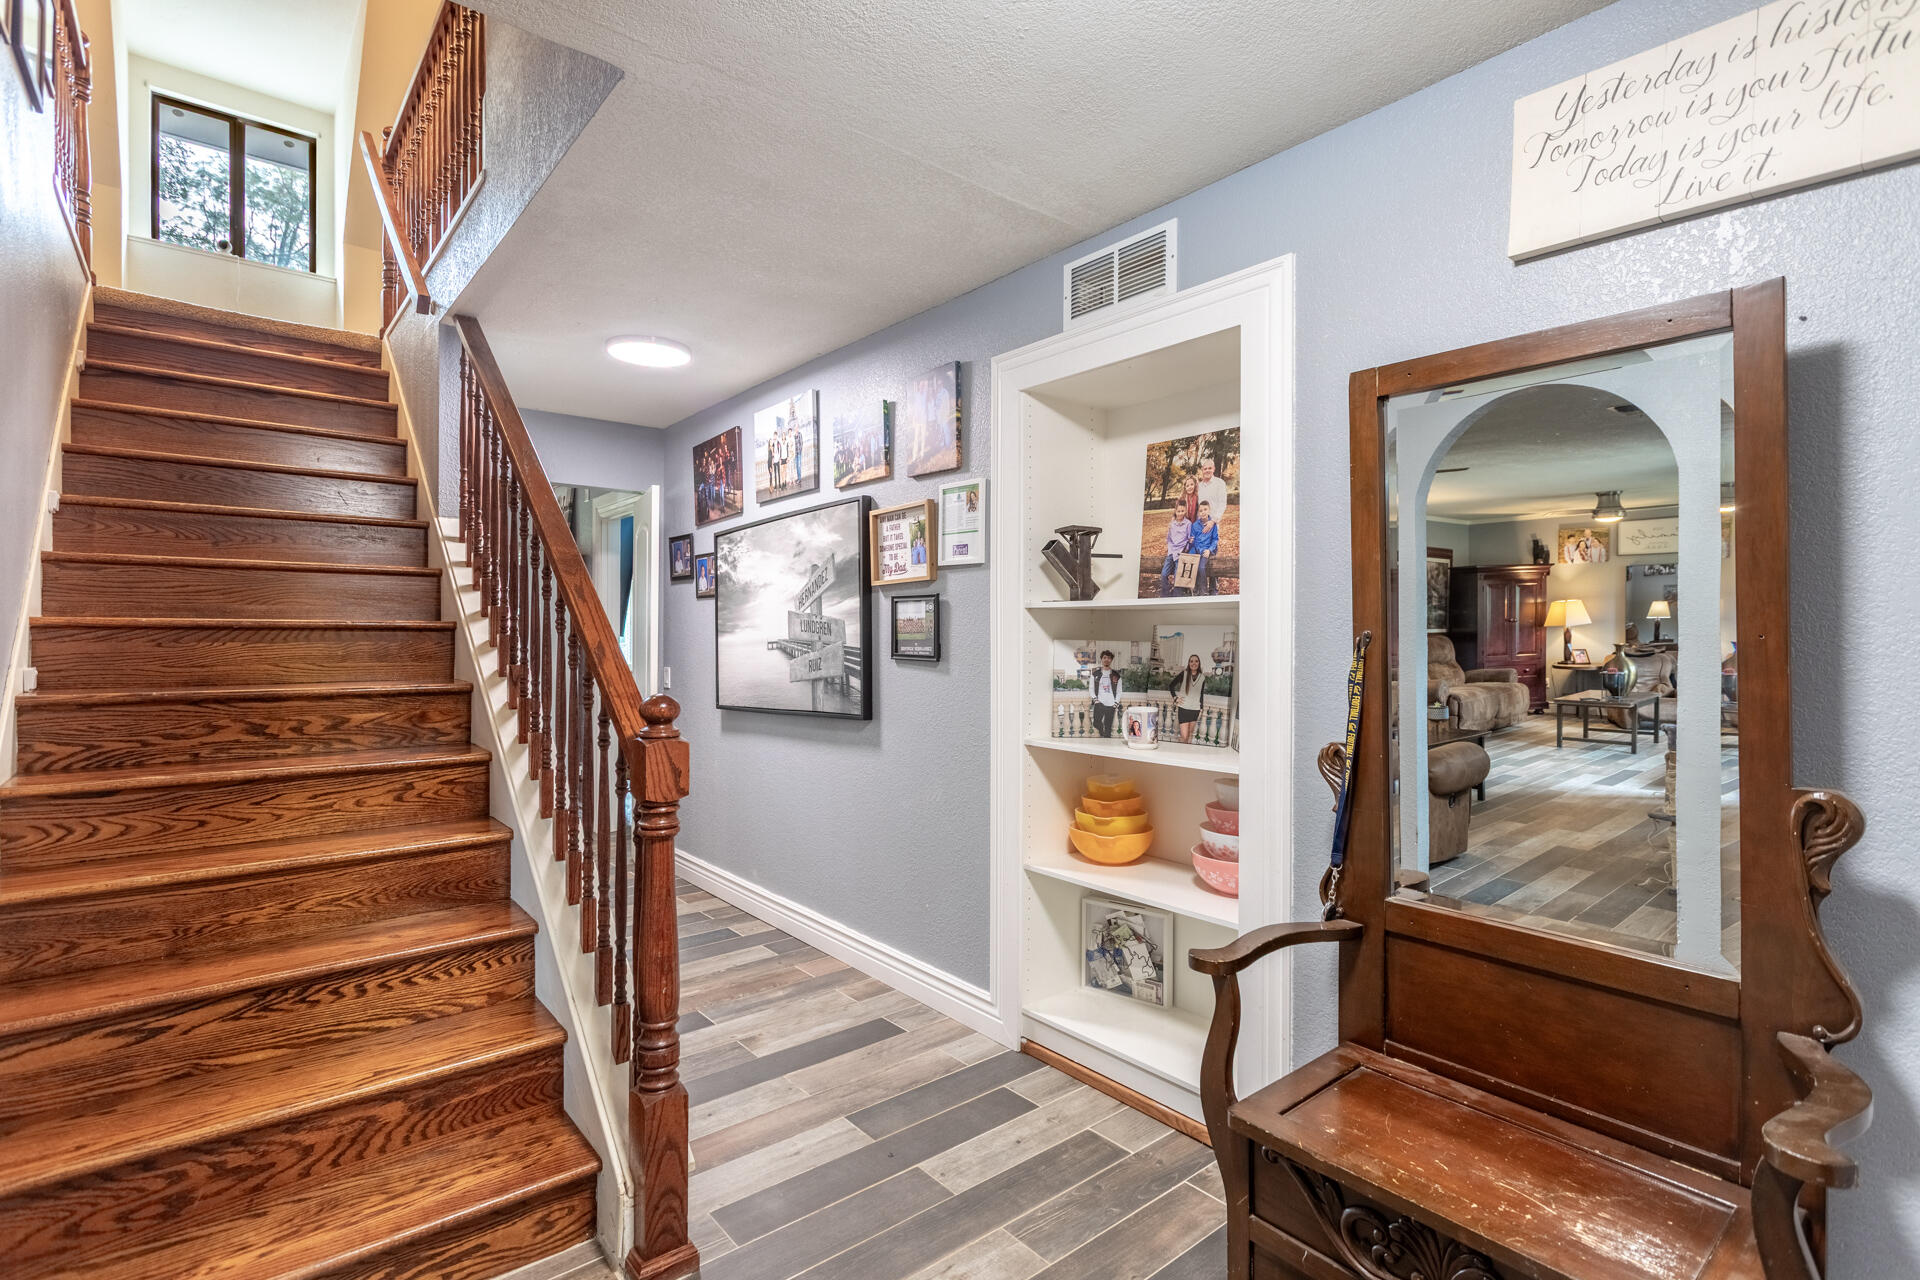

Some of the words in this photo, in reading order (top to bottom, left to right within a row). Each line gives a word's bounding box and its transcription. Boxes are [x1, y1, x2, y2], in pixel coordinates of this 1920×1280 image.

[1523, 109, 1680, 169] Tomorrow
[1685, 91, 1714, 121] is
[1708, 62, 1809, 124] your
[1801, 21, 1920, 92] futu
[1550, 48, 1718, 138] Yesterday
[1728, 34, 1759, 64] is
[1566, 145, 1669, 193] Today
[1678, 132, 1706, 161] is
[1701, 109, 1802, 169] your
[1818, 70, 1894, 130] life.
[1654, 164, 1734, 208] Live
[1743, 146, 1783, 183] it.
[798, 566, 829, 609] HERNANDEZ
[1181, 562, 1194, 579] H
[800, 619, 832, 637] LUNDGREN
[808, 656, 822, 673] RUIZ
